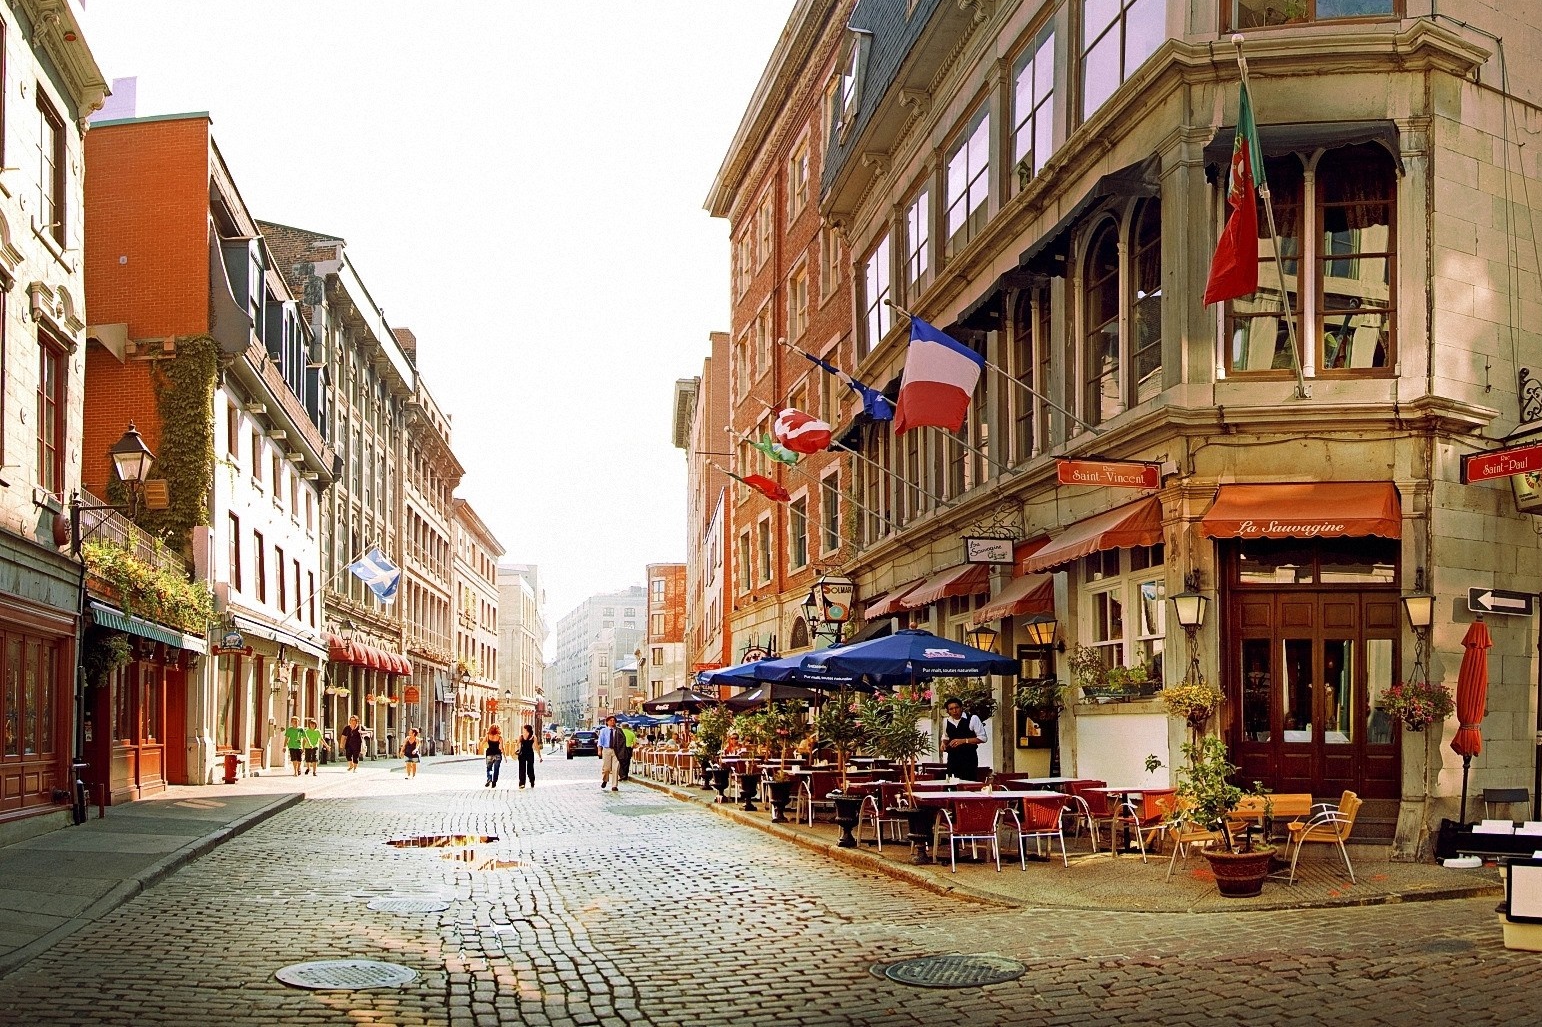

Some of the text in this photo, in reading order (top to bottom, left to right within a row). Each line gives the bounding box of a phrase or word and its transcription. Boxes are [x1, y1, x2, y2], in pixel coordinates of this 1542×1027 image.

[1482, 456, 1528, 476] Saint-Paul
[1072, 469, 1146, 485] Saint-Vincent
[1234, 520, 1346, 537] La Sauvagine
[823, 584, 852, 595] SOLMAR
